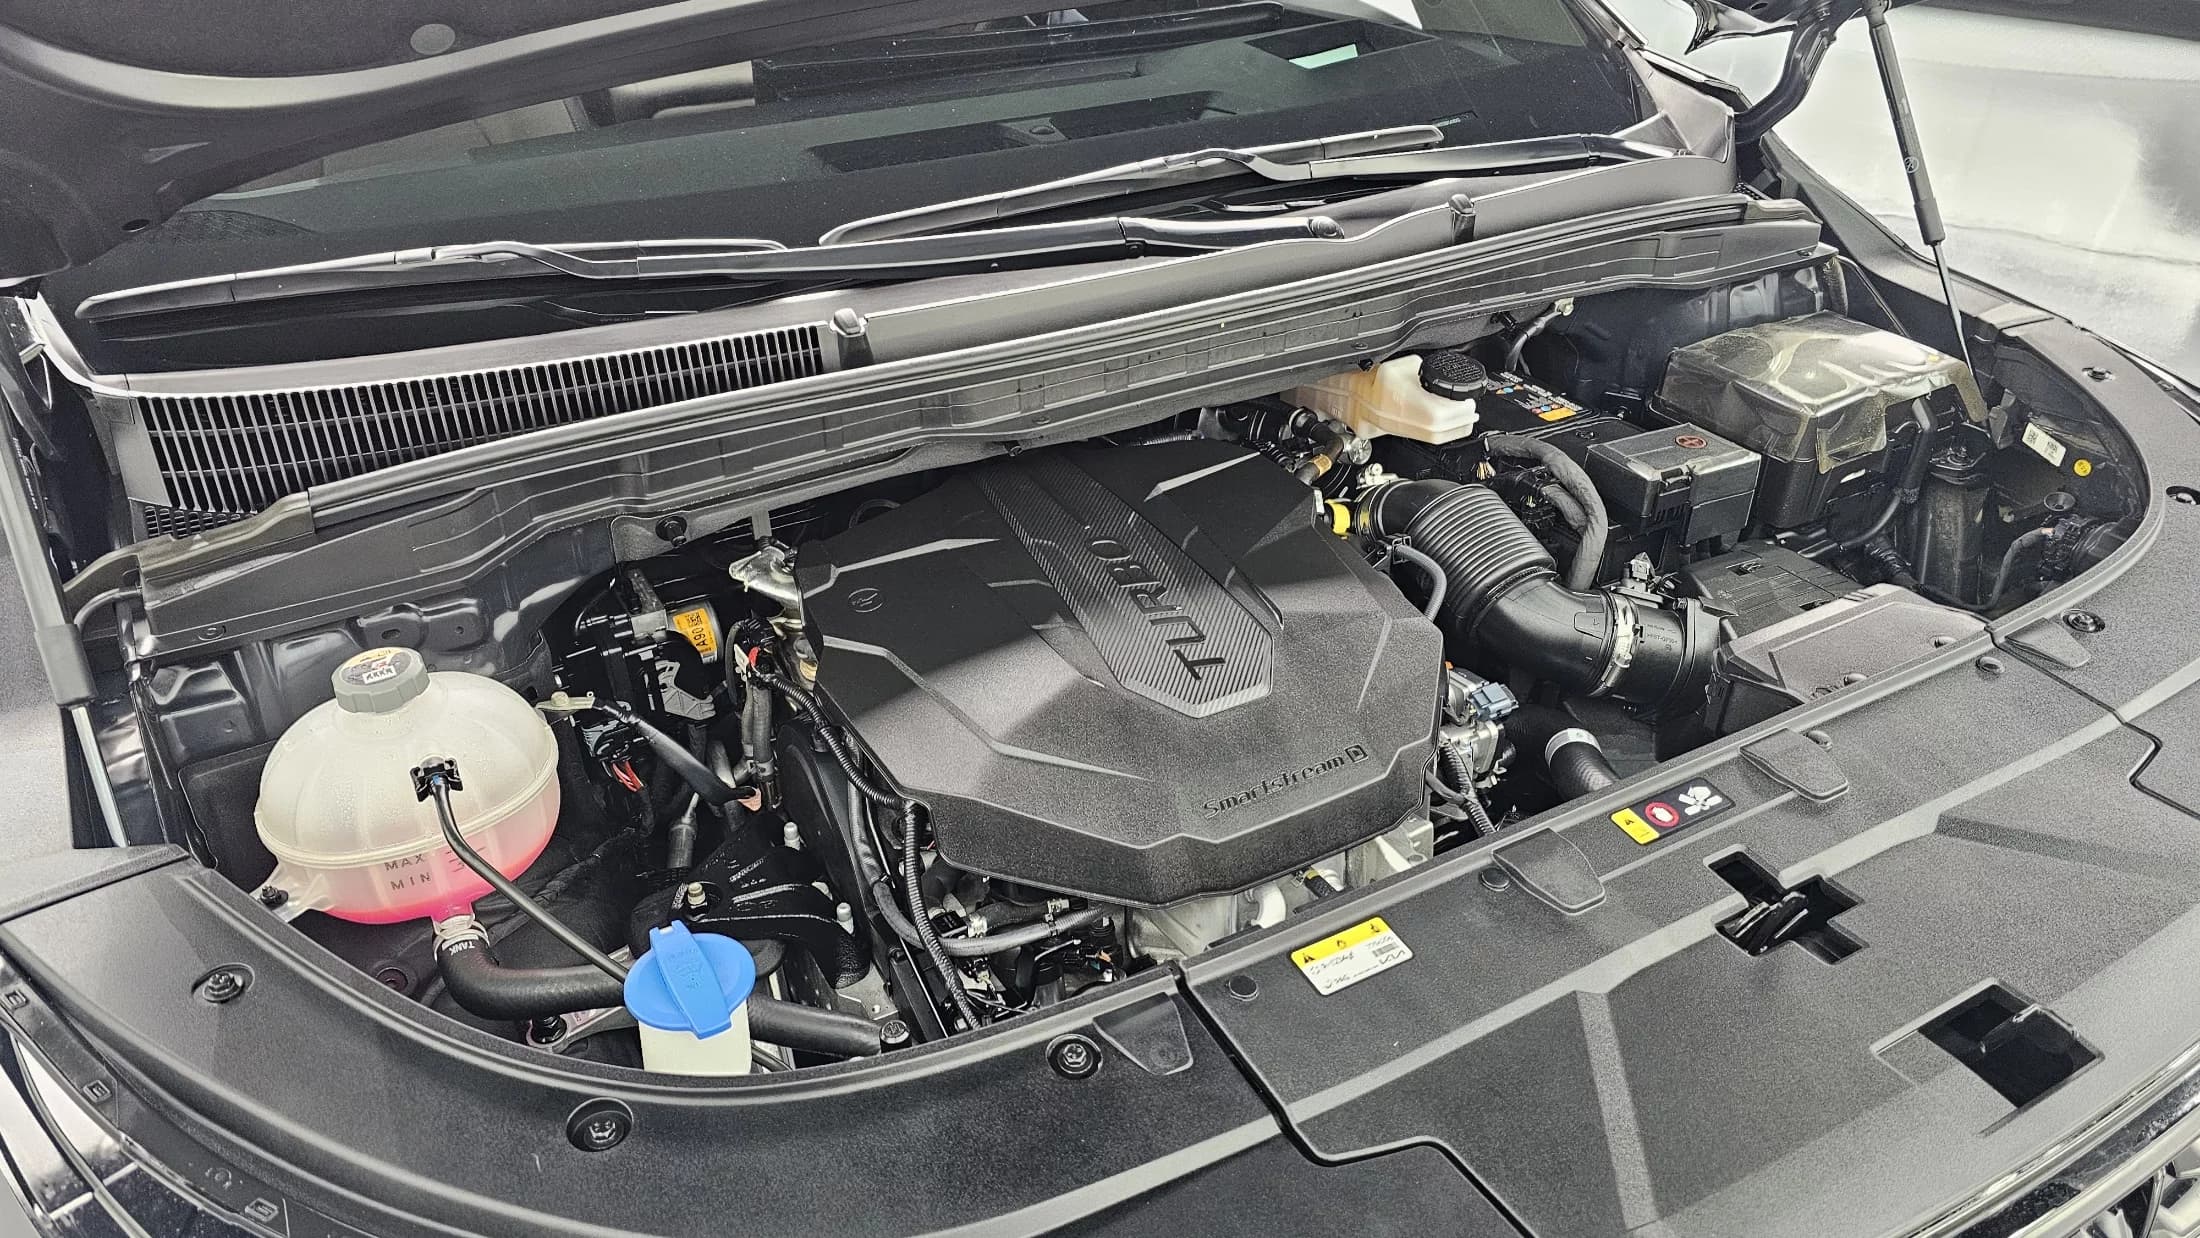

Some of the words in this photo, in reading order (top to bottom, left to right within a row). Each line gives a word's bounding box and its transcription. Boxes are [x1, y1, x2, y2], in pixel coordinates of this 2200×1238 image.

[1089, 538, 1226, 680] TURBO
[691, 627, 708, 648] A90
[1203, 755, 1346, 821] Smartstream
[384, 854, 426, 871] MAX
[390, 871, 432, 891] MIN
[448, 940, 476, 956] TANK
